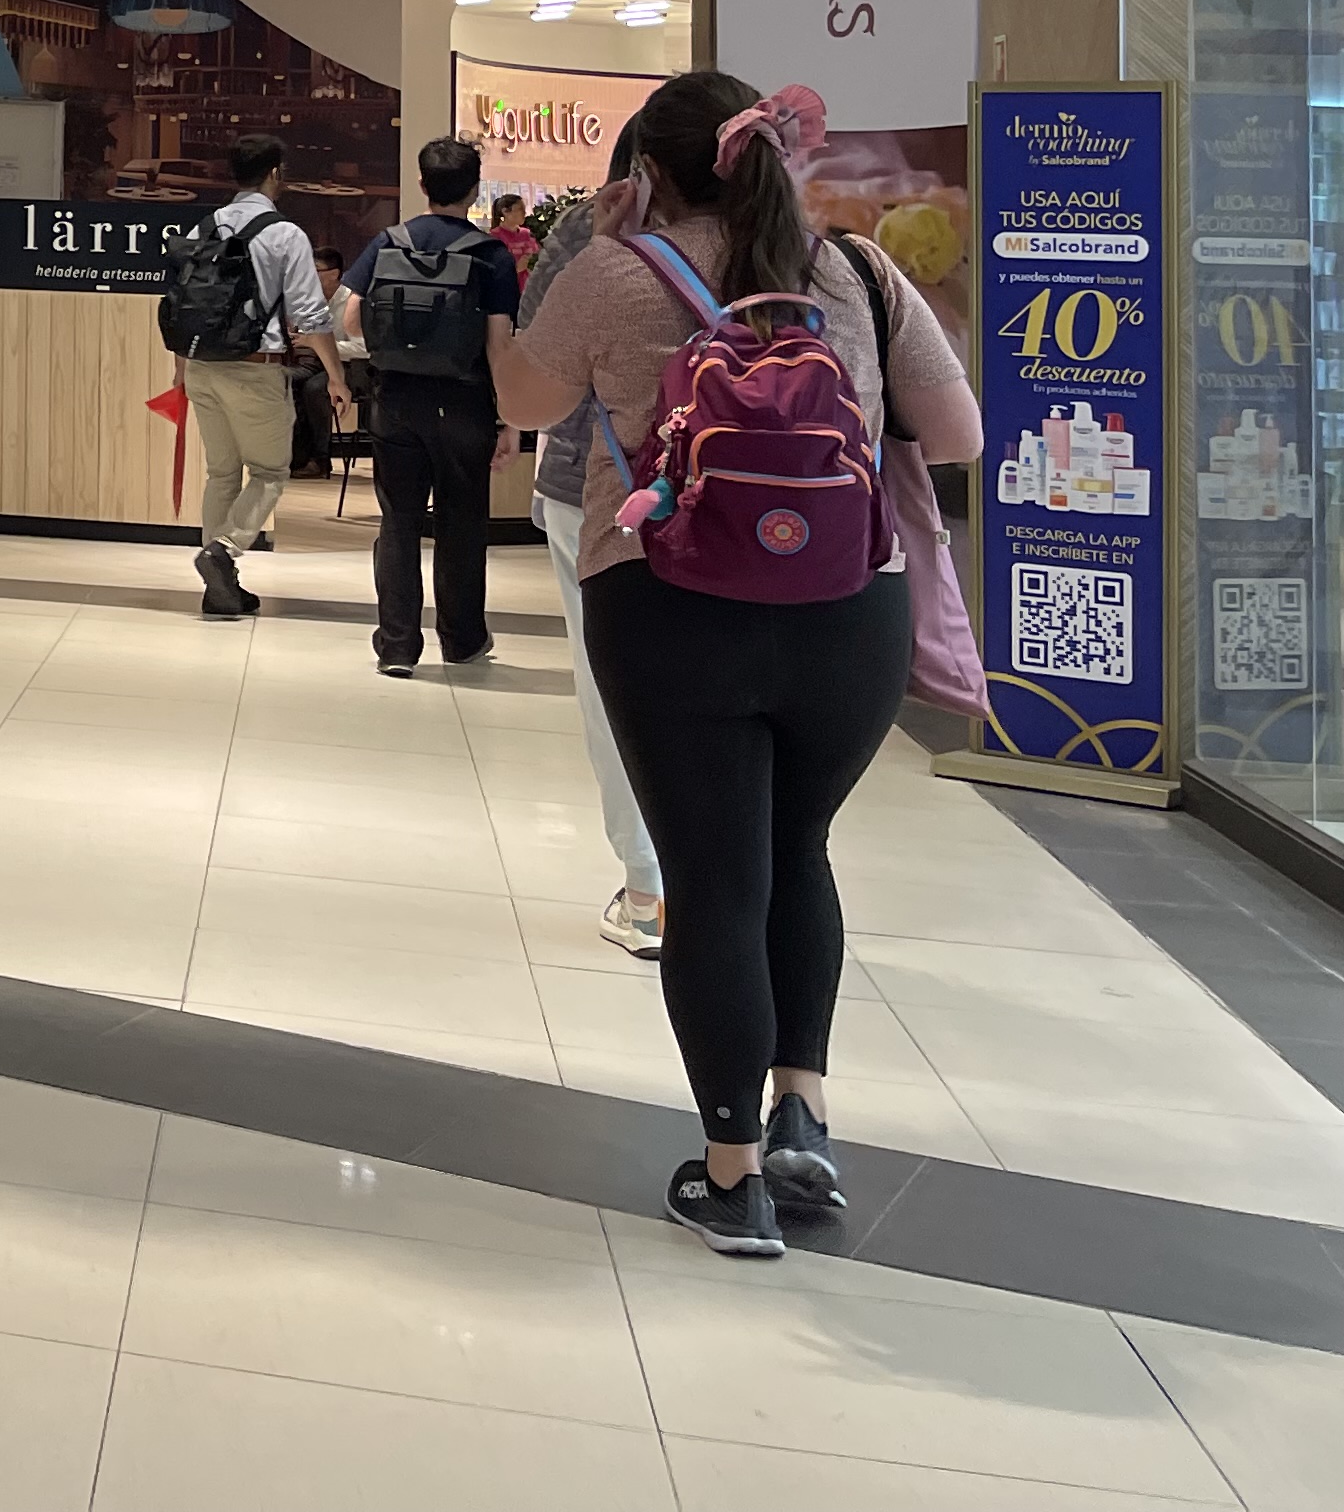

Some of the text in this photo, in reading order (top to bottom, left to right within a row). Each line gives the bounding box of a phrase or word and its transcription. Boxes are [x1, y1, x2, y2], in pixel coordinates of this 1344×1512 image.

[1028, 128, 1130, 160] coaching
[1042, 155, 1110, 166] Salcobrand
[1020, 188, 1121, 208] USA AQUÍ
[999, 209, 1143, 230] TUS CÓDIGOS
[1004, 237, 1140, 255] MiSalcobrand
[35, 264, 166, 282] heladería artesanal
[999, 272, 1143, 285] y puedes obtener hasta un
[998, 288, 1145, 361] 40%
[1019, 358, 1146, 386] descuento
[1033, 384, 1137, 399] En productos adheridos
[1005, 525, 1141, 550] DESCARGA LA APP
[1012, 542, 1134, 565] E INSCRÍBETE EN
